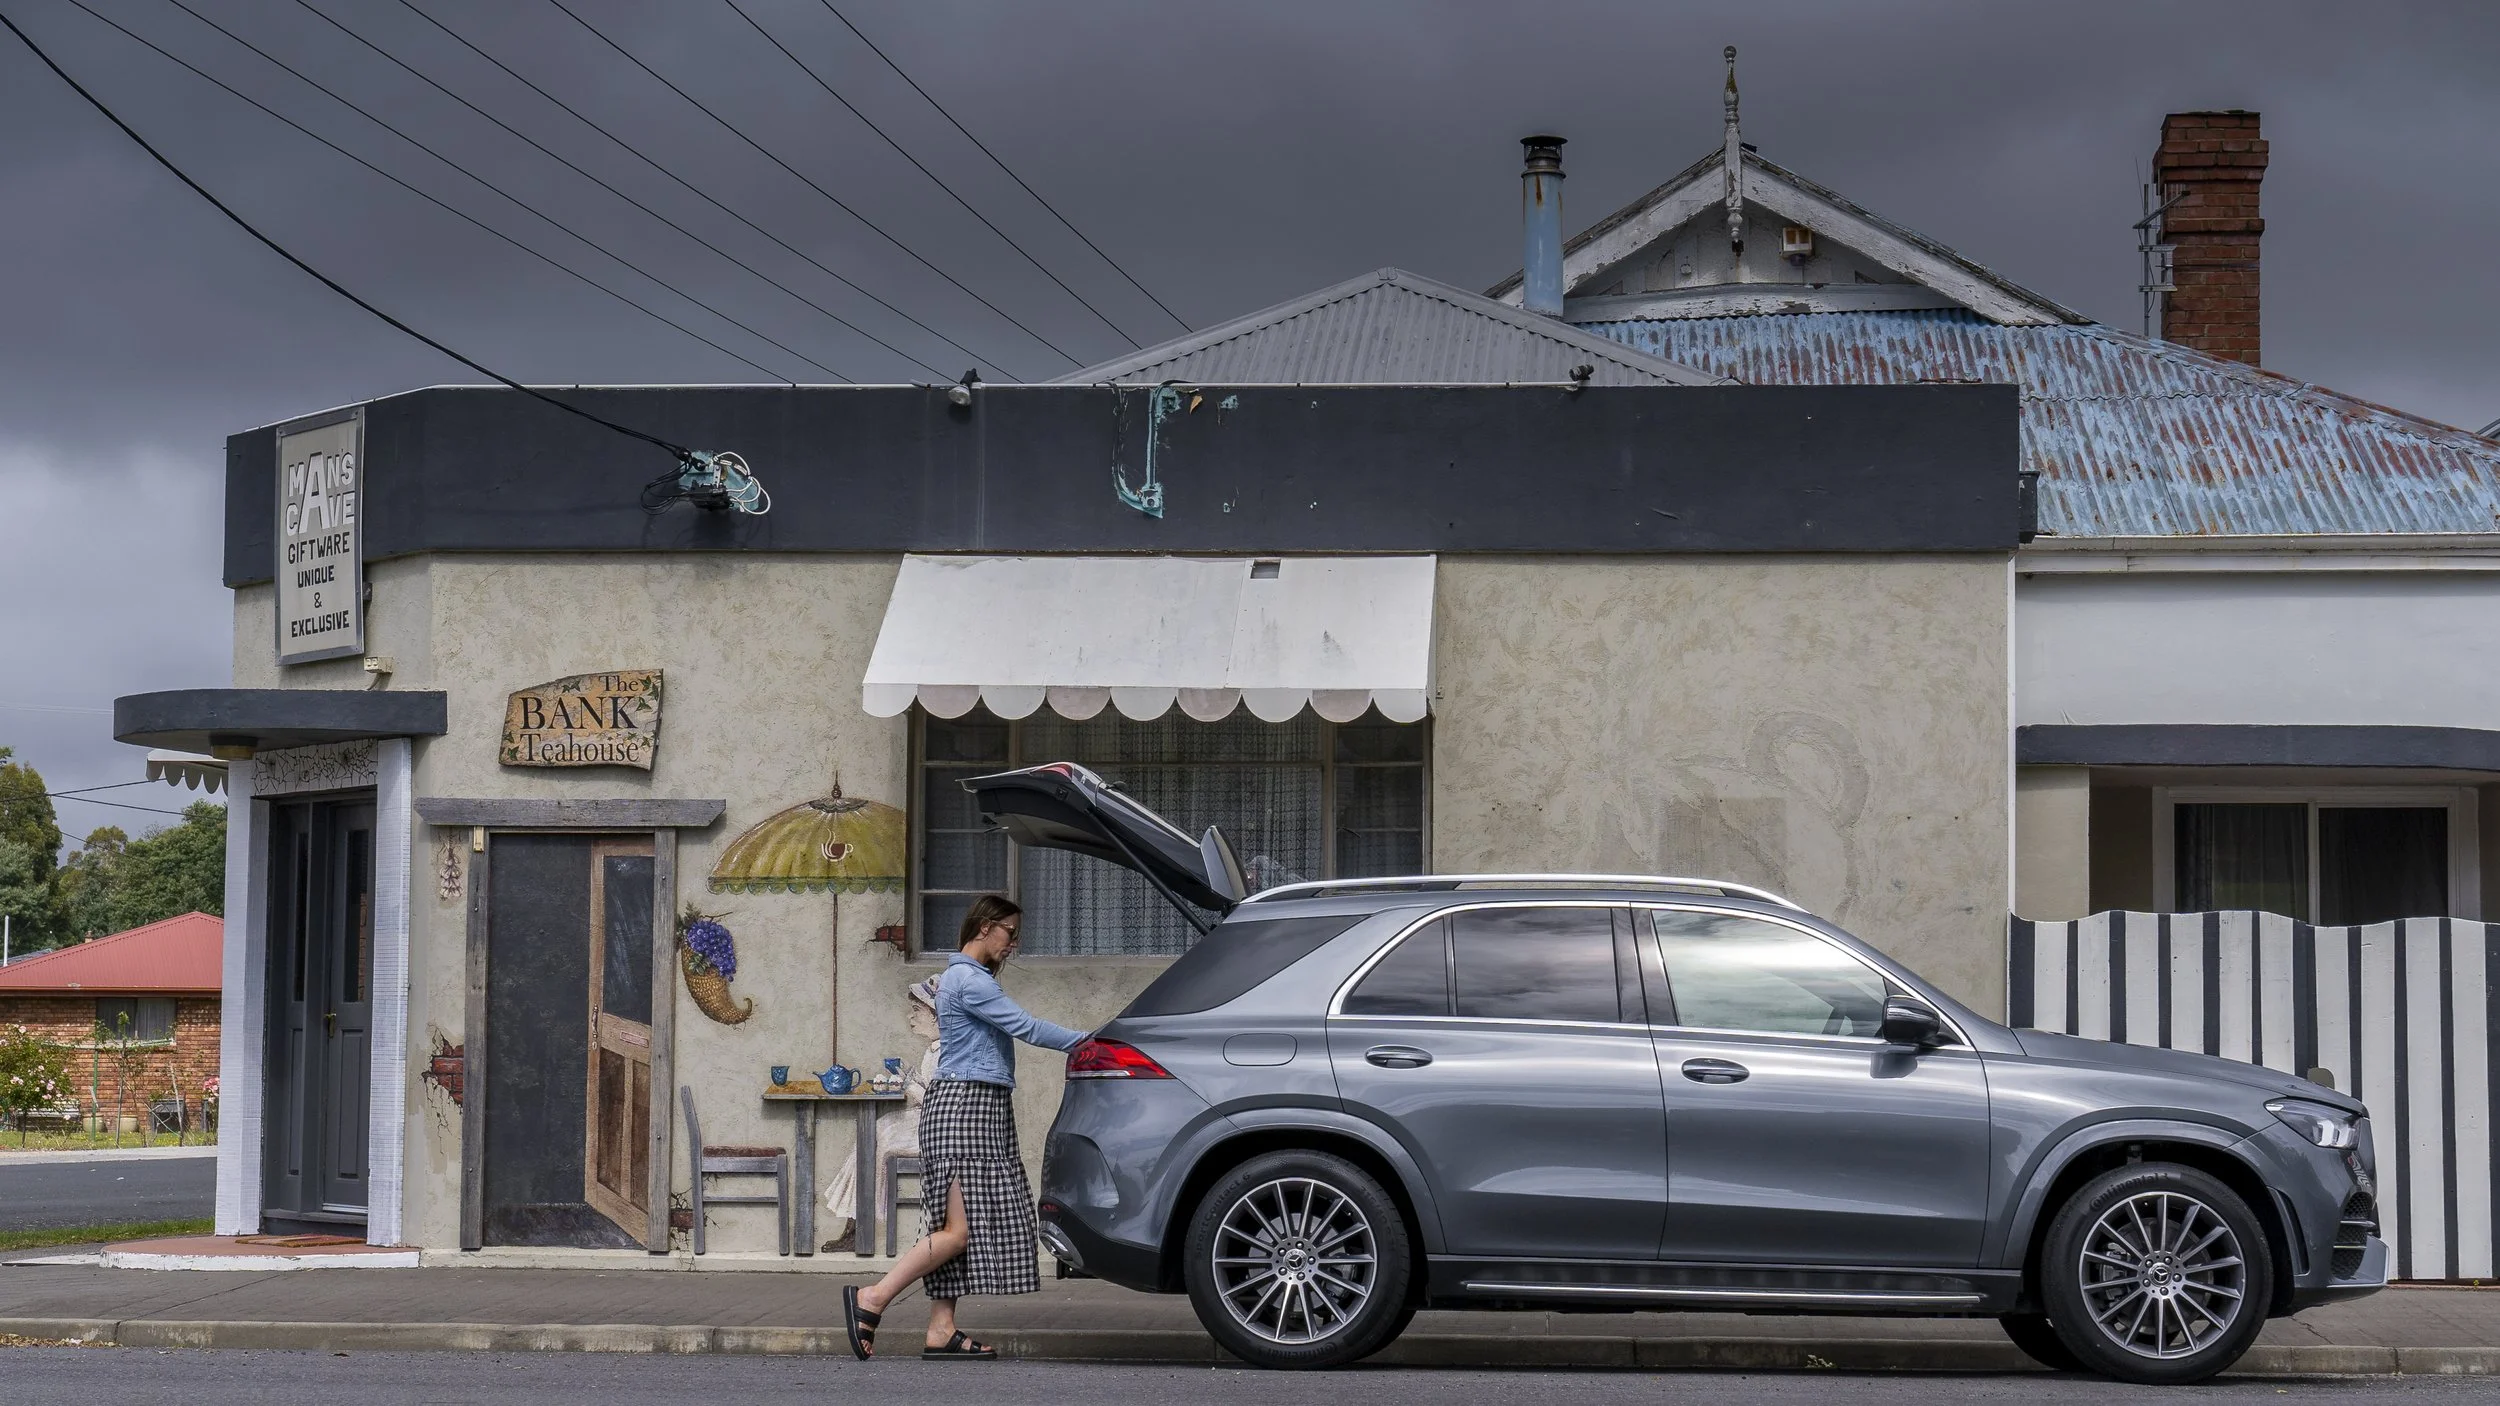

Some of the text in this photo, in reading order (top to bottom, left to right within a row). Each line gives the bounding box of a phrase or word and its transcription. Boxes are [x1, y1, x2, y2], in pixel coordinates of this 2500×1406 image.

[286, 490, 356, 537] CAVE
[288, 531, 351, 565] GIFTWARE
[297, 565, 335, 589] UNIQUE
[313, 592, 323, 609] &
[291, 610, 350, 638] EXCLUSIVE
[600, 675, 639, 692] The
[519, 696, 638, 730] BANK
[520, 733, 639, 763] Teahouse
[2089, 1172, 2160, 1211] Continental
